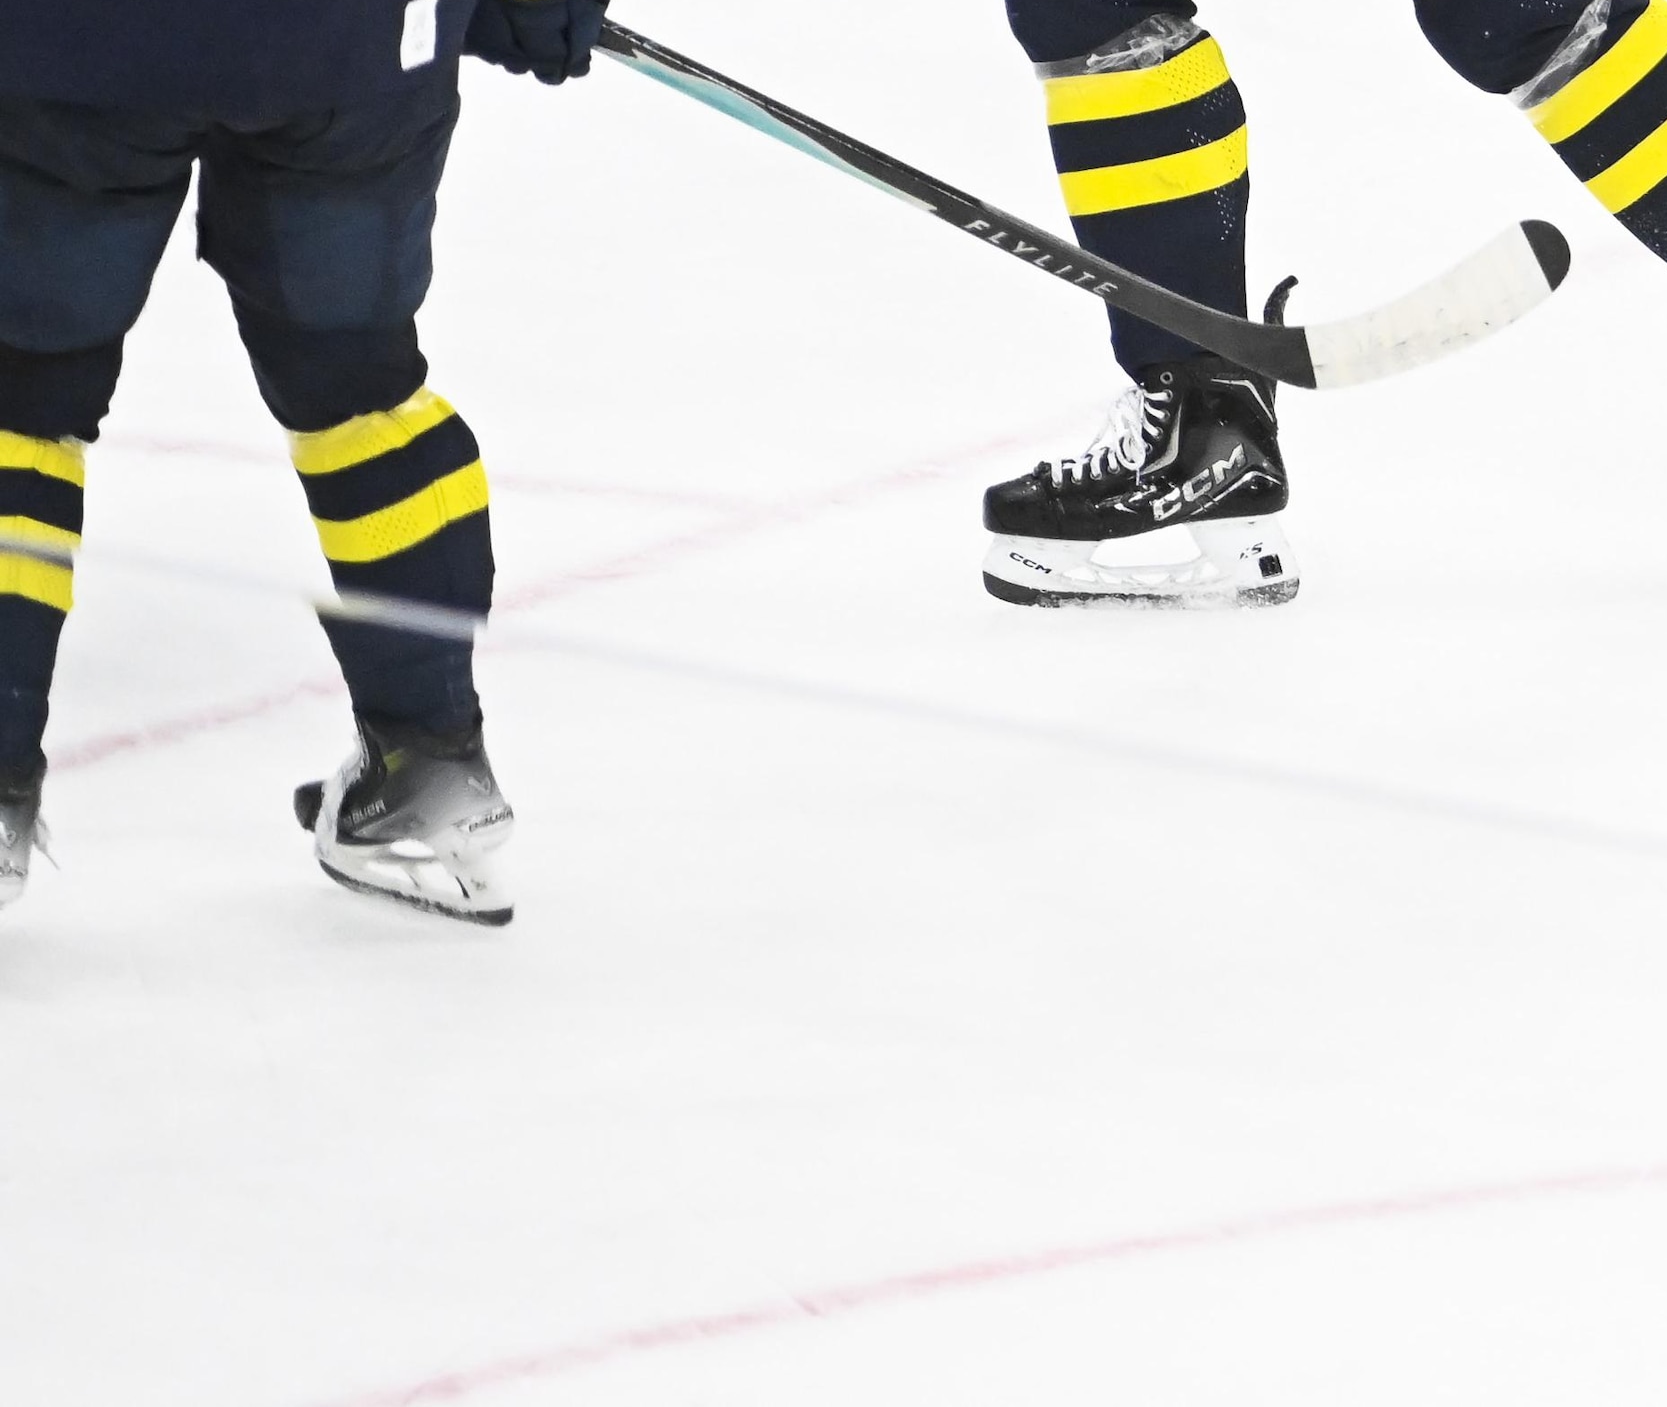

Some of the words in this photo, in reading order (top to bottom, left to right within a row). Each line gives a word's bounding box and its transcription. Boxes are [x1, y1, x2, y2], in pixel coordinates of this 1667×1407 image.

[963, 218, 1120, 296] FLYLITE
[1151, 443, 1248, 522] CCM
[1008, 550, 1053, 575] CCM
